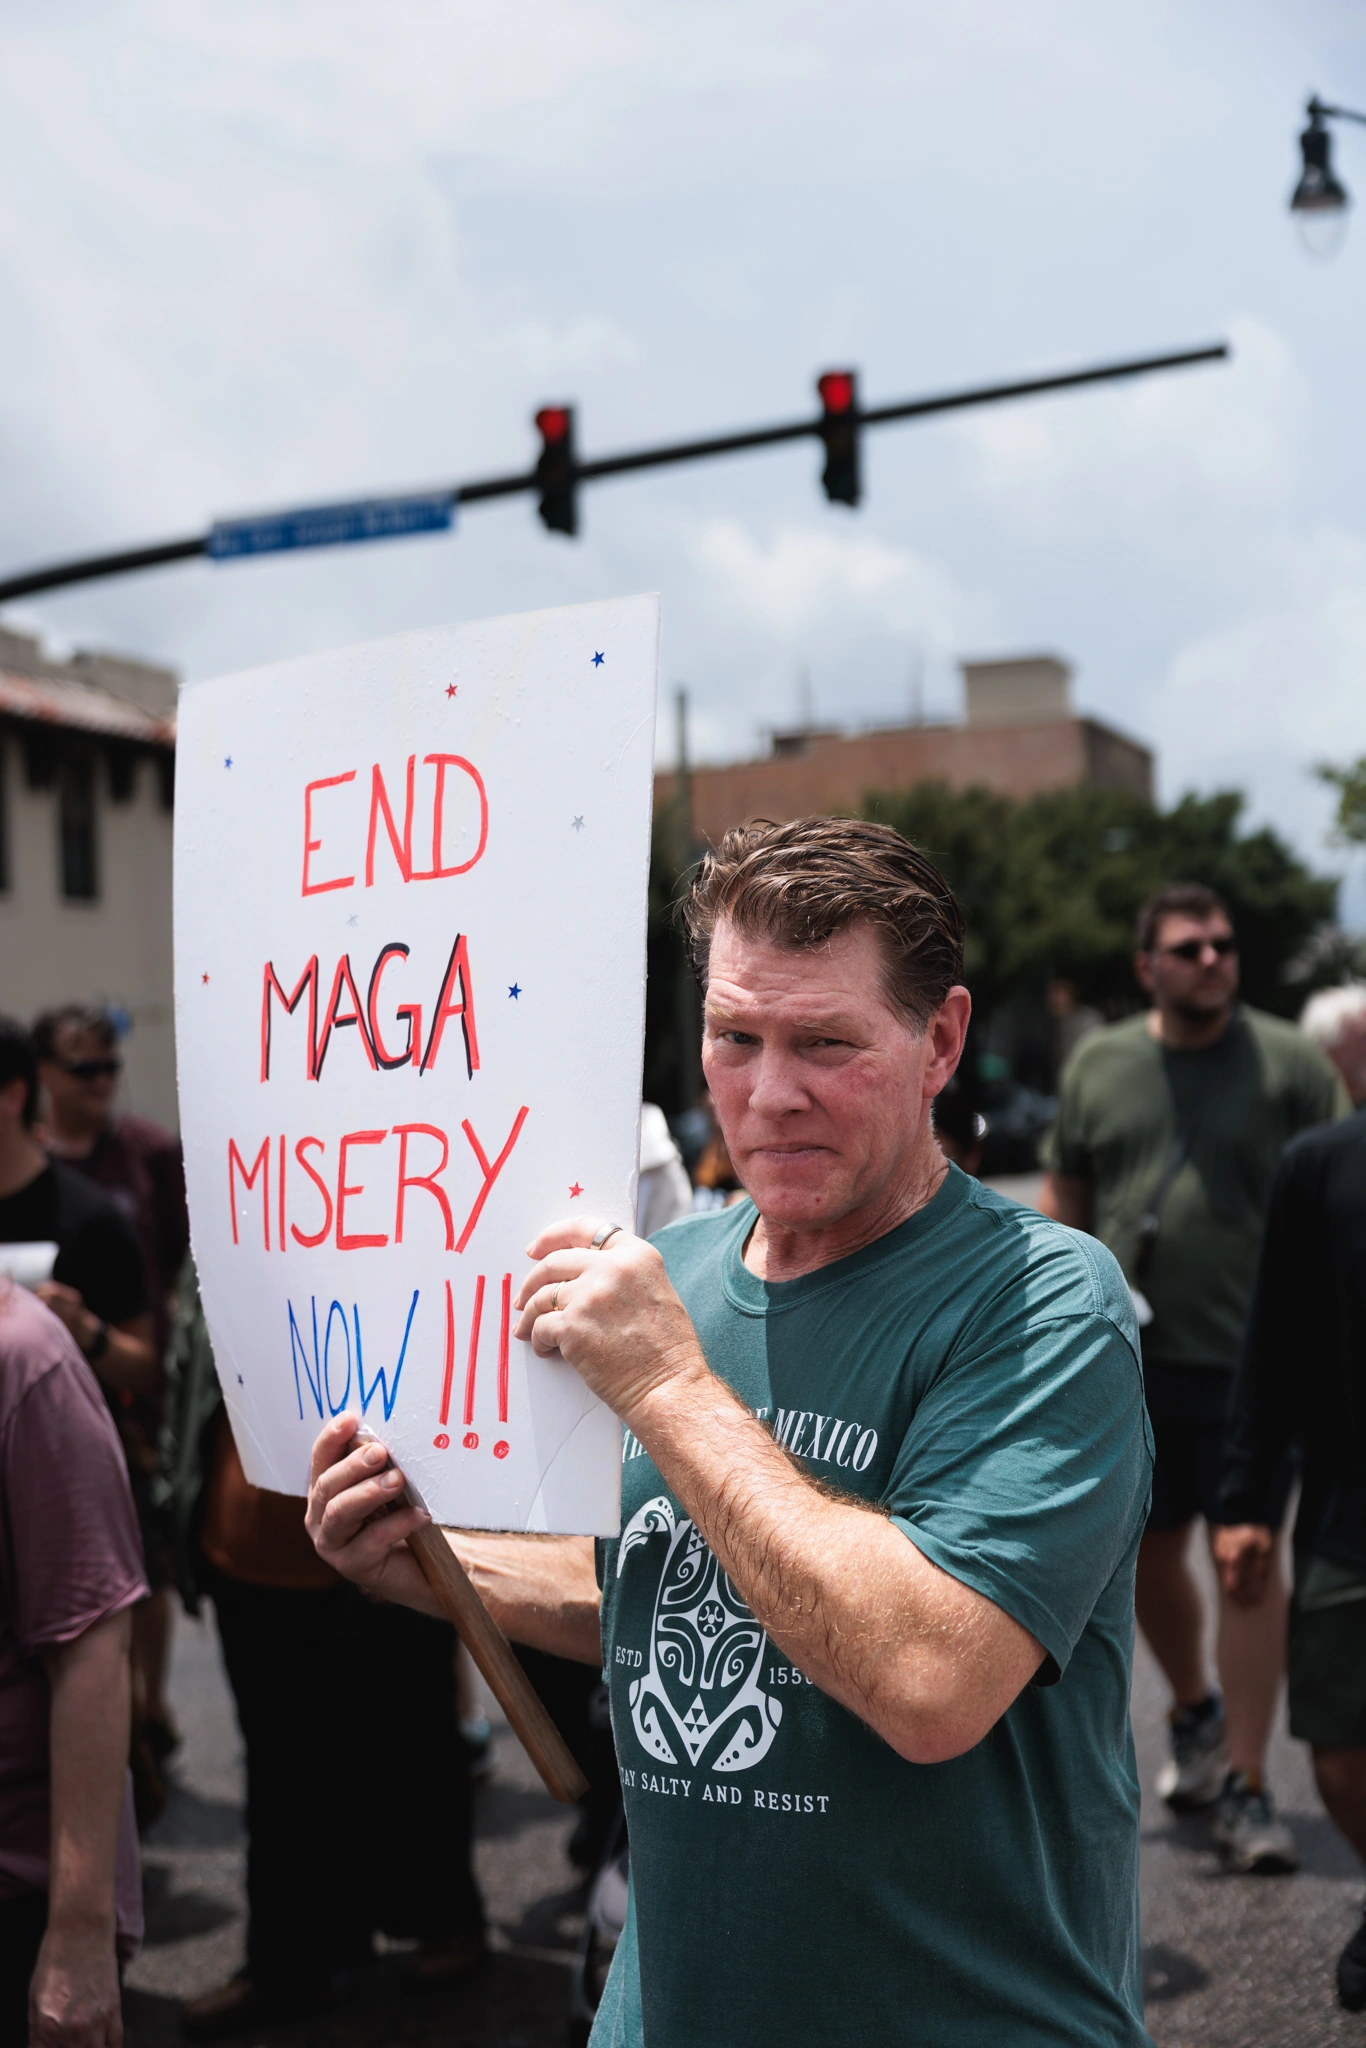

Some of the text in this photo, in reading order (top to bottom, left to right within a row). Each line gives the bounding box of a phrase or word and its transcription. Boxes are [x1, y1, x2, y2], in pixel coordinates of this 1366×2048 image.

[302, 754, 488, 897] END
[260, 933, 480, 1083] MAGA
[228, 1106, 529, 1254] MISERY
[287, 1289, 420, 1422] NOW
[772, 1408, 878, 1472] MEXICO
[615, 1645, 643, 1668] ESTD
[641, 1772, 692, 1797] SALTY
[702, 1784, 742, 1805] AND
[753, 1789, 829, 1813] RESIST
